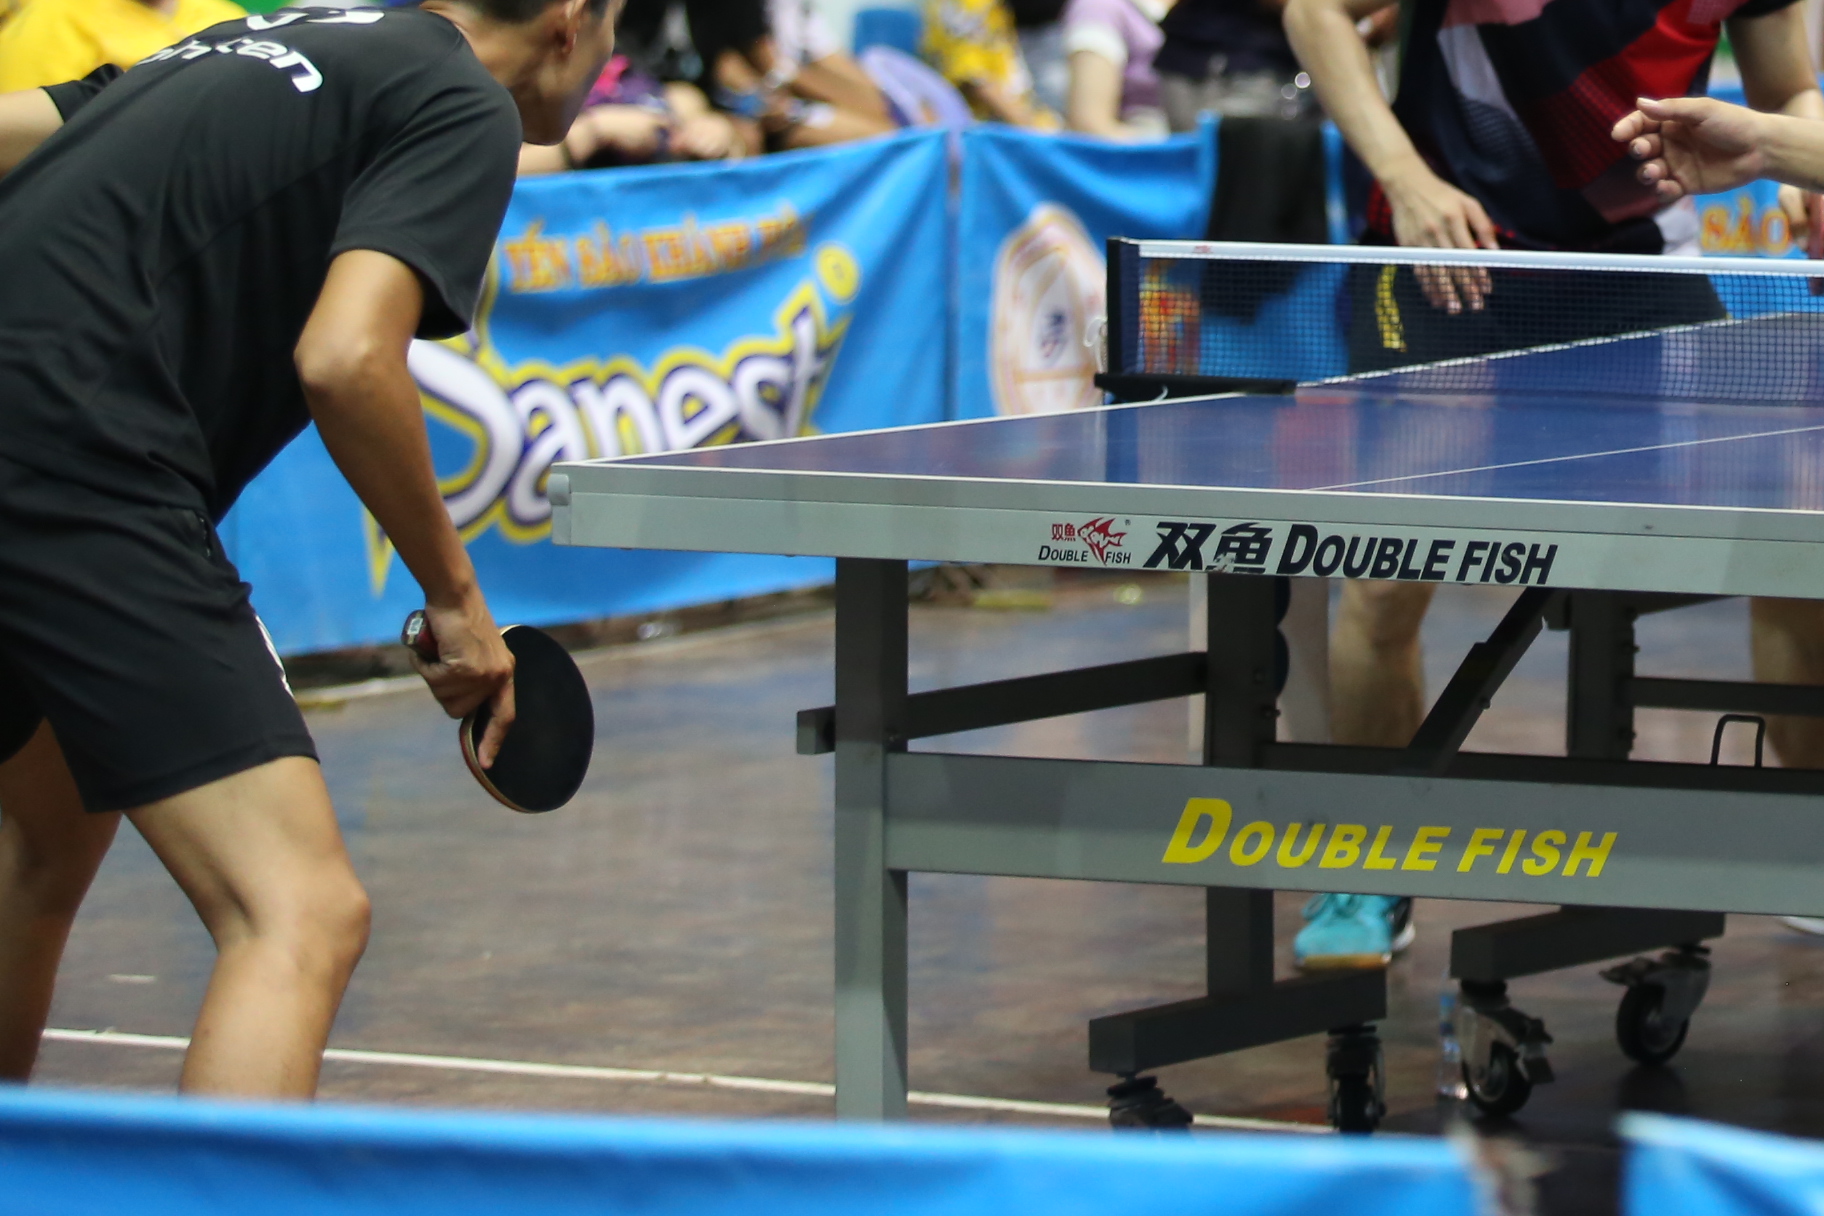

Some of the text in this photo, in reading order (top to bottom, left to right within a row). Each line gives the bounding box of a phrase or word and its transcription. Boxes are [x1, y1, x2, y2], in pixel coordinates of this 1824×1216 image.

[1038, 545, 1131, 564] DOUBLE FISH
[1276, 524, 1455, 581] DOUBLE
[1456, 541, 1558, 585] FISH
[1161, 797, 1618, 877] DOUBLE FISH
